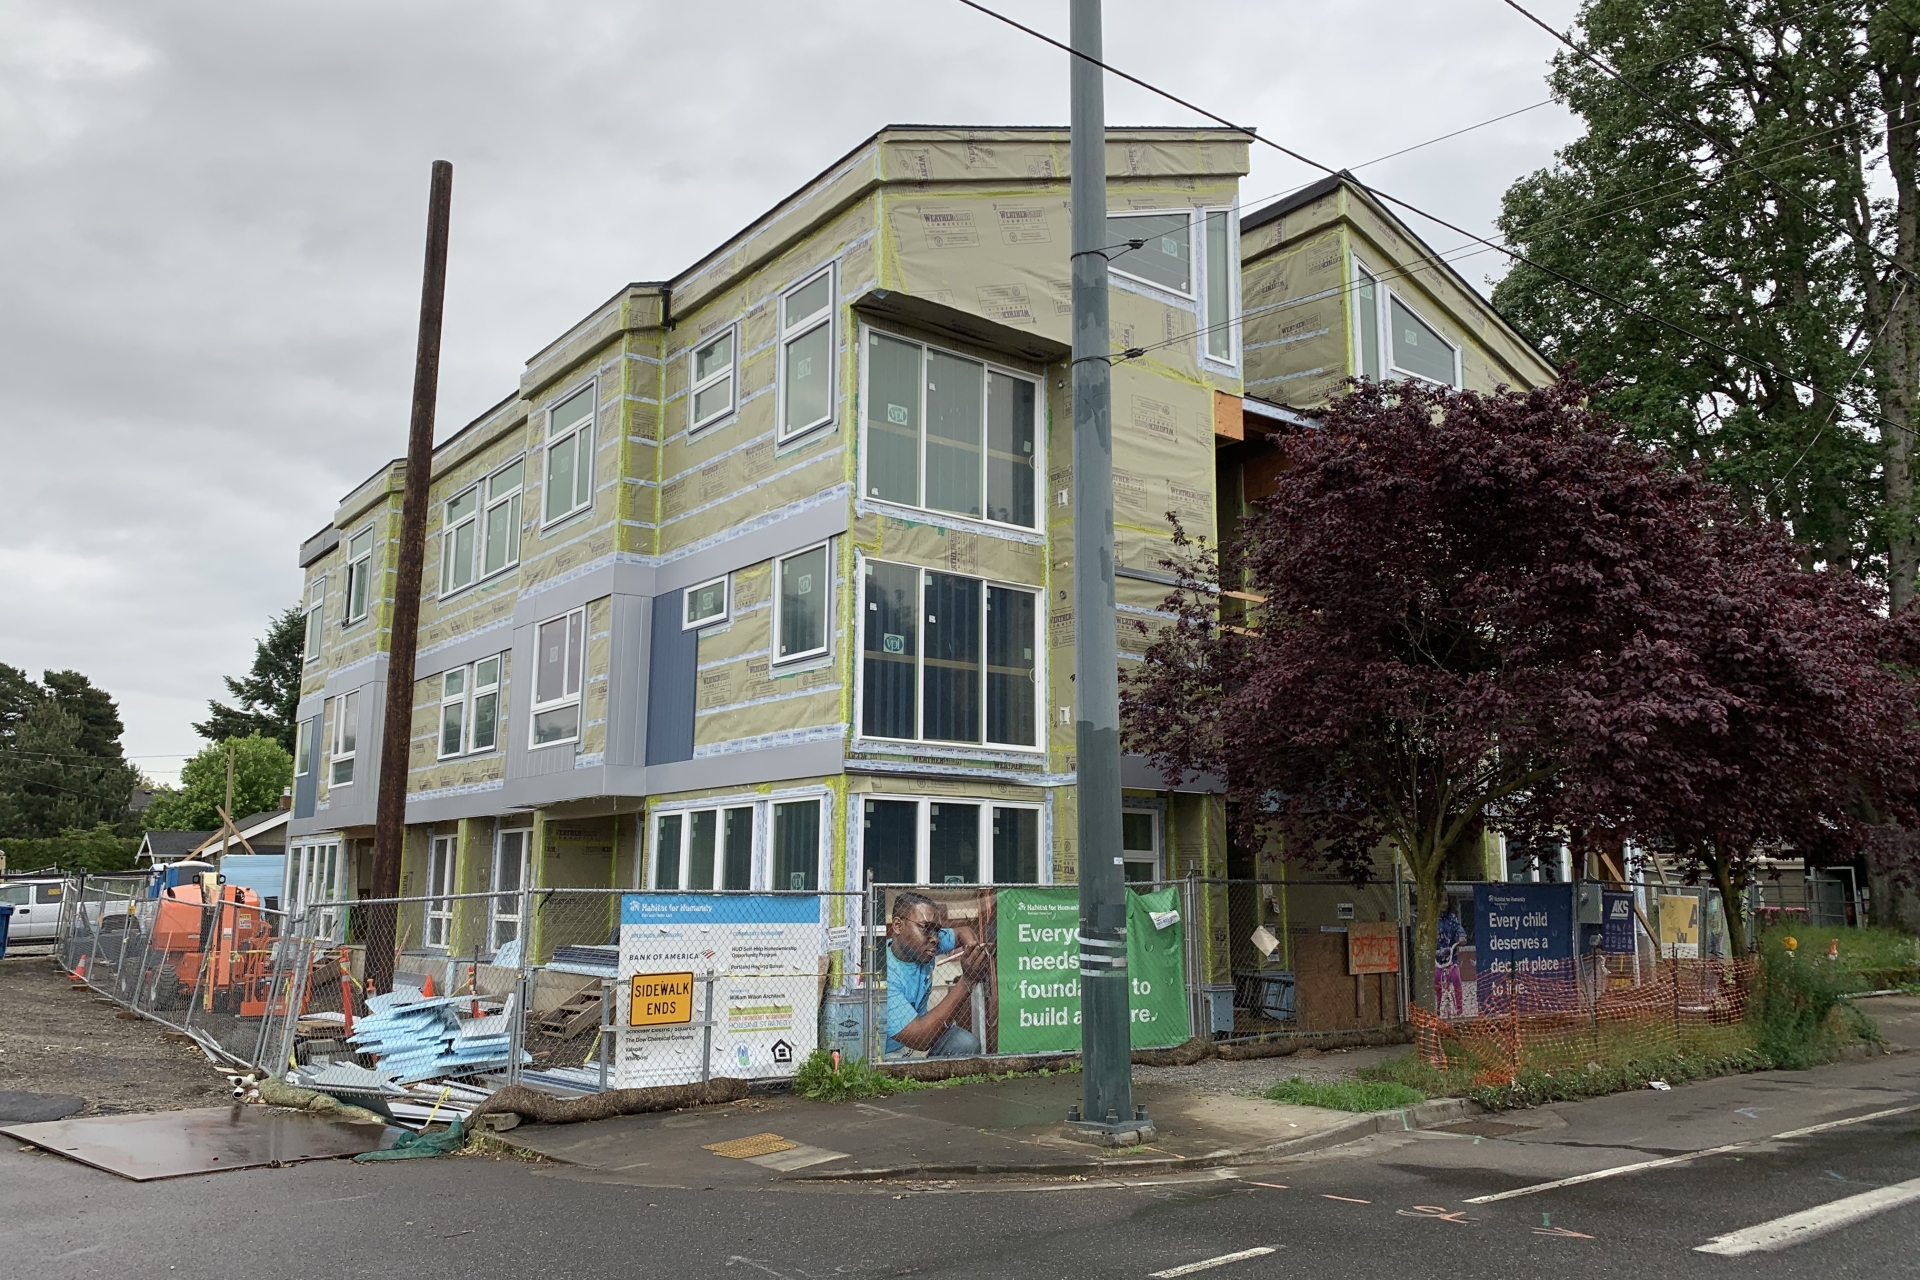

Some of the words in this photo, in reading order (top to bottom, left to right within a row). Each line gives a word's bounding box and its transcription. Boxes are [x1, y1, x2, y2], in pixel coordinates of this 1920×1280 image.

[641, 903, 668, 911] Habitat
[669, 903, 679, 911] for
[681, 903, 712, 913] Humanity
[1612, 900, 1629, 914] AKS
[1489, 912, 1520, 930] Every
[1522, 912, 1548, 927] child
[1351, 935, 1398, 961] OFFICE
[1489, 935, 1540, 950] deserves
[1541, 937, 1549, 948] a
[1018, 951, 1080, 971] needs
[1532, 956, 1559, 974] place
[634, 982, 690, 998] SIDEWALK
[1132, 977, 1151, 995] to
[1492, 981, 1503, 996] to
[646, 1001, 676, 1016] ENDS
[1020, 1006, 1068, 1027] build
